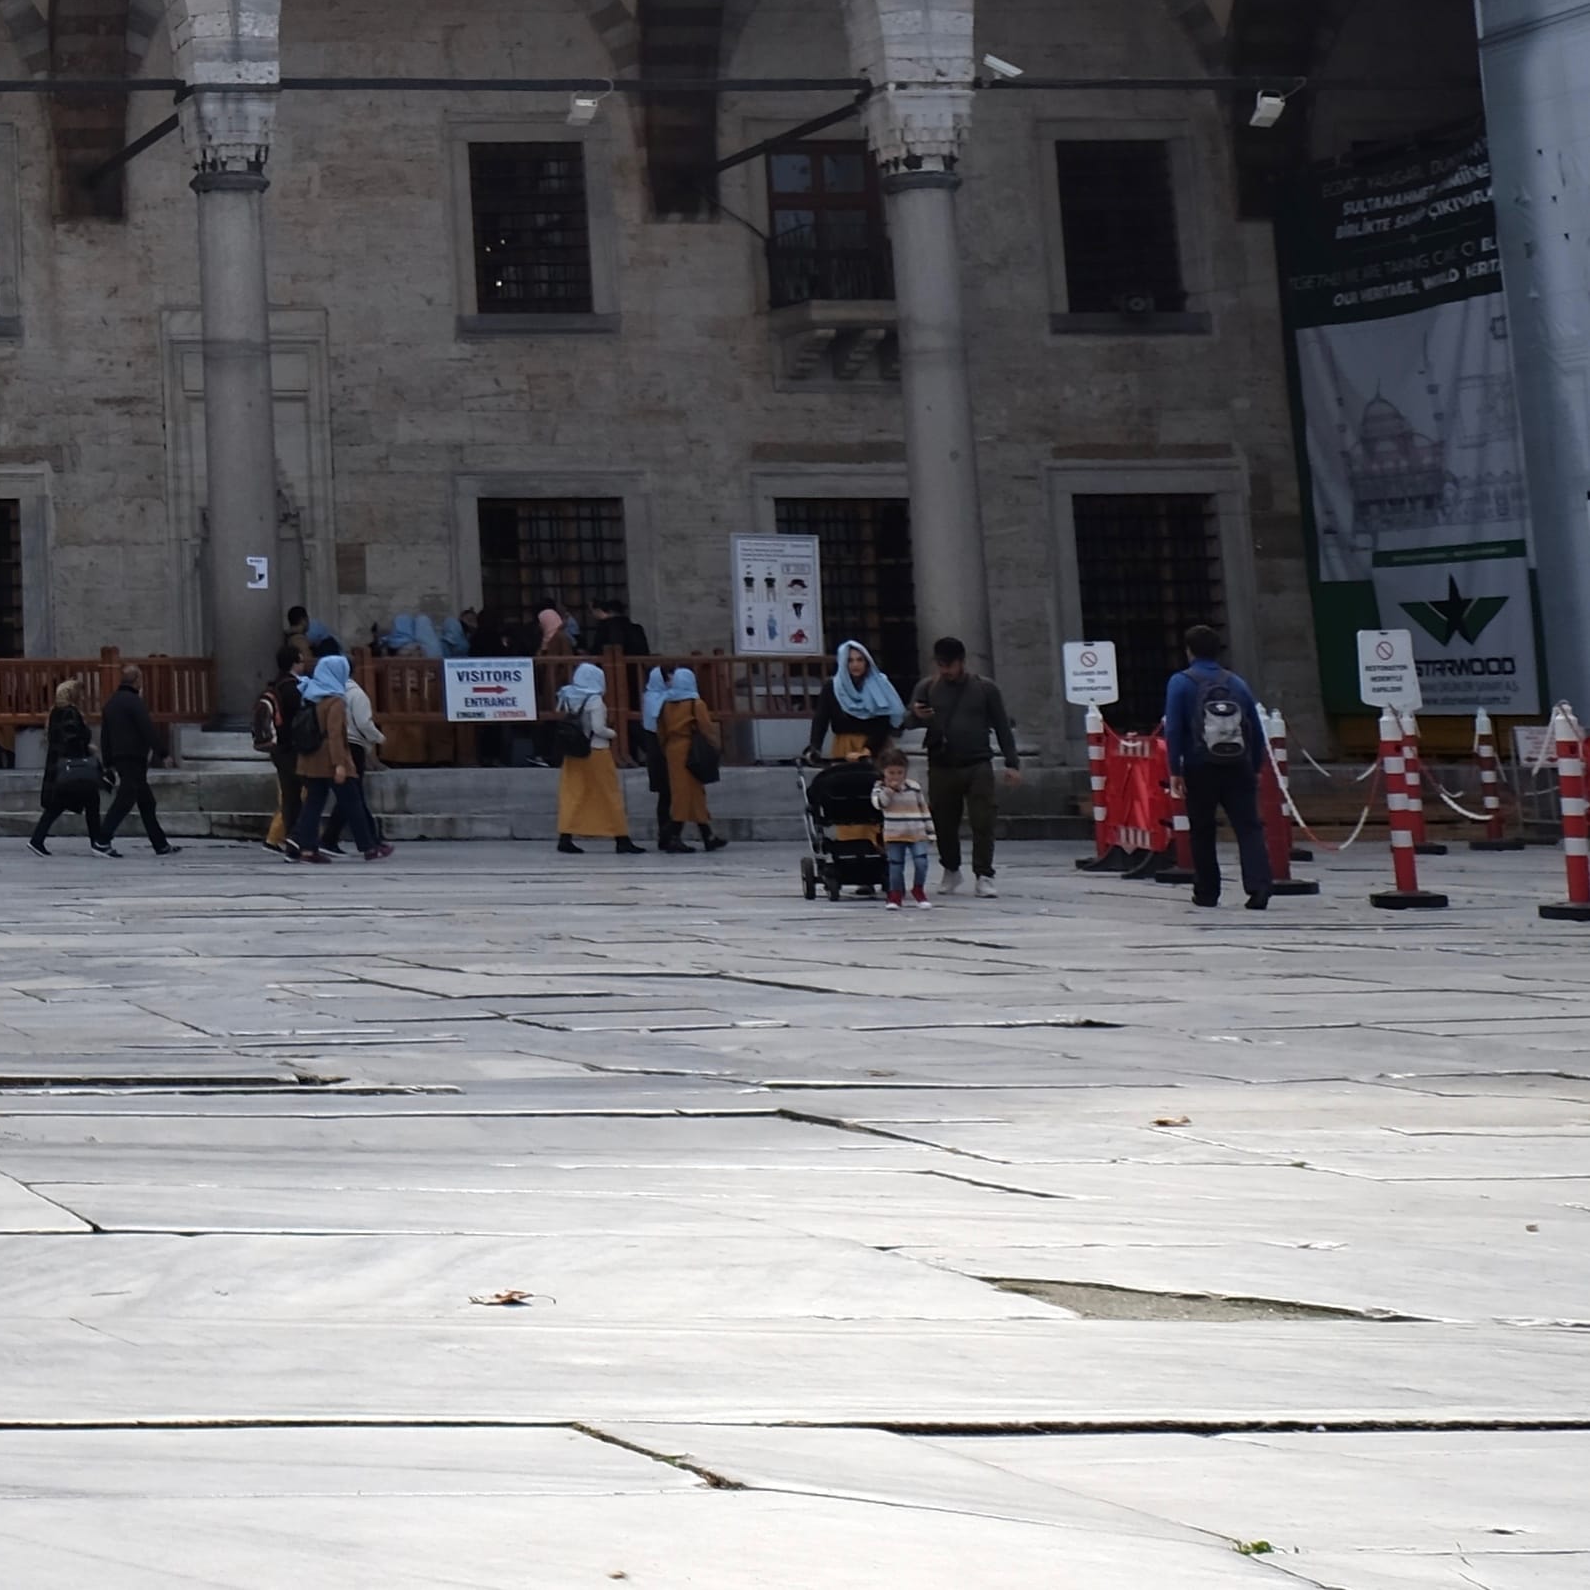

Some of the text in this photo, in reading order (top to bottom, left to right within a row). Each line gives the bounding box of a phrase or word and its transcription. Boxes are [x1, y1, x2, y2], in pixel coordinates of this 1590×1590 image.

[1415, 657, 1517, 677] STARWOOD
[457, 670, 522, 682] VISITORS
[464, 697, 518, 707] ENTRANCE
